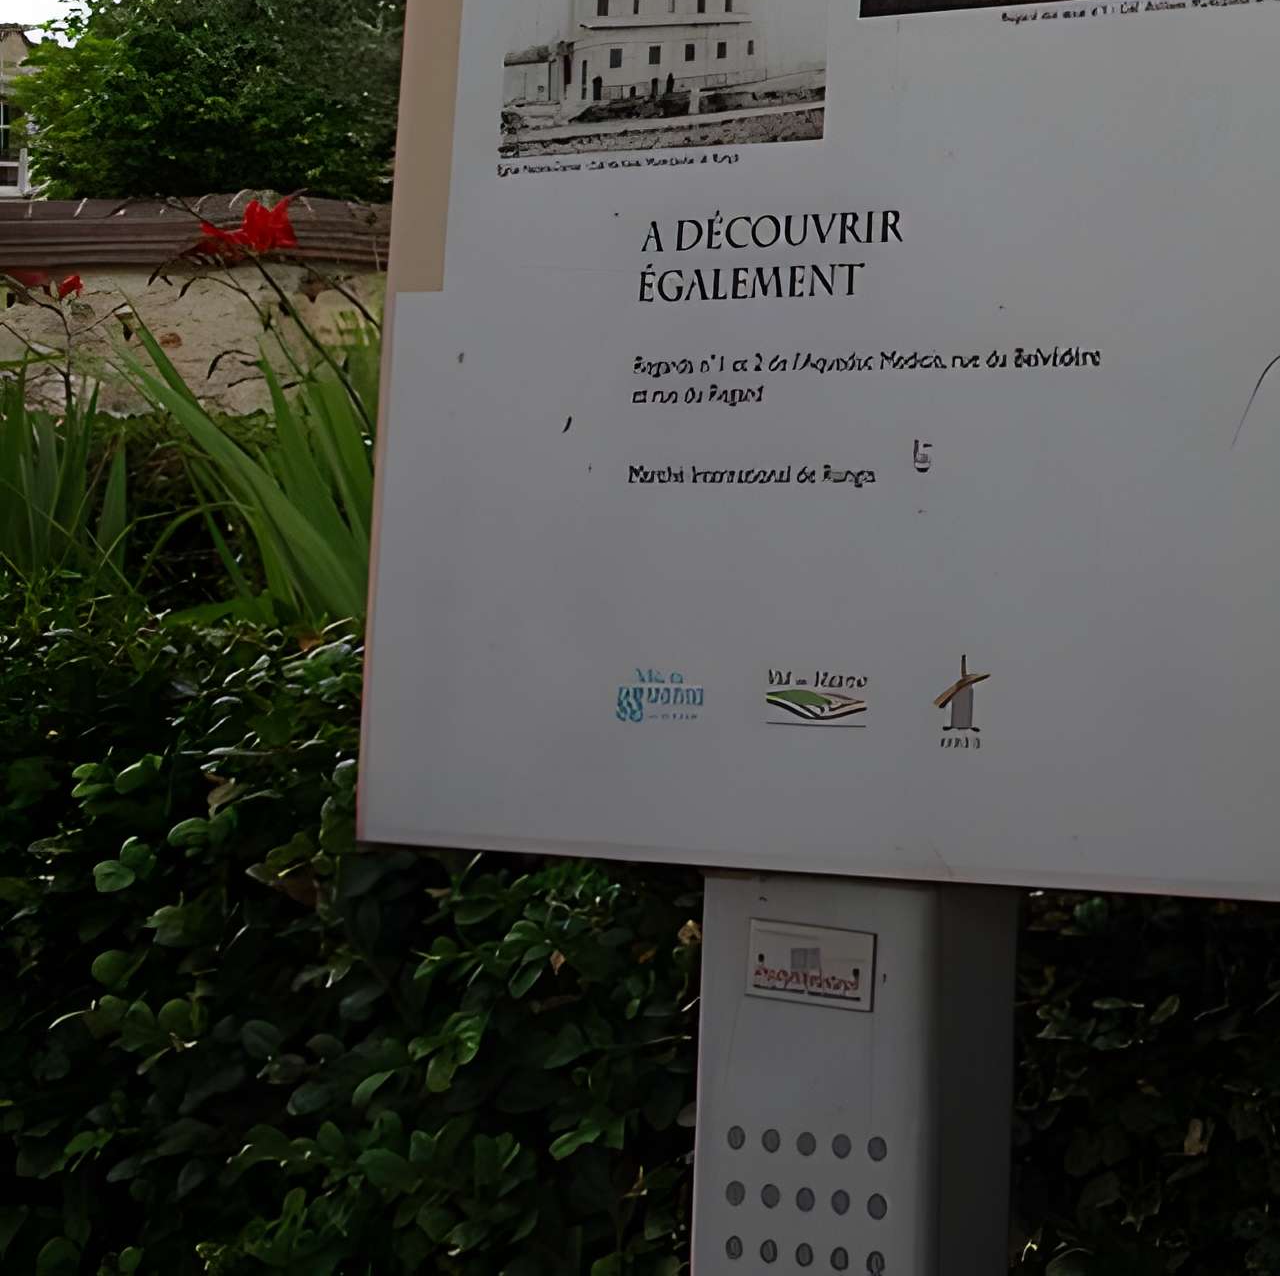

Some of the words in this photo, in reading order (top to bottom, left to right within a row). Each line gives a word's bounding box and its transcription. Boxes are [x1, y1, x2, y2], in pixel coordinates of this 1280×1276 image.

[641, 221, 664, 252] A
[676, 210, 903, 251] DÉCOUVRIR
[638, 263, 865, 302] ÉGALEMENT
